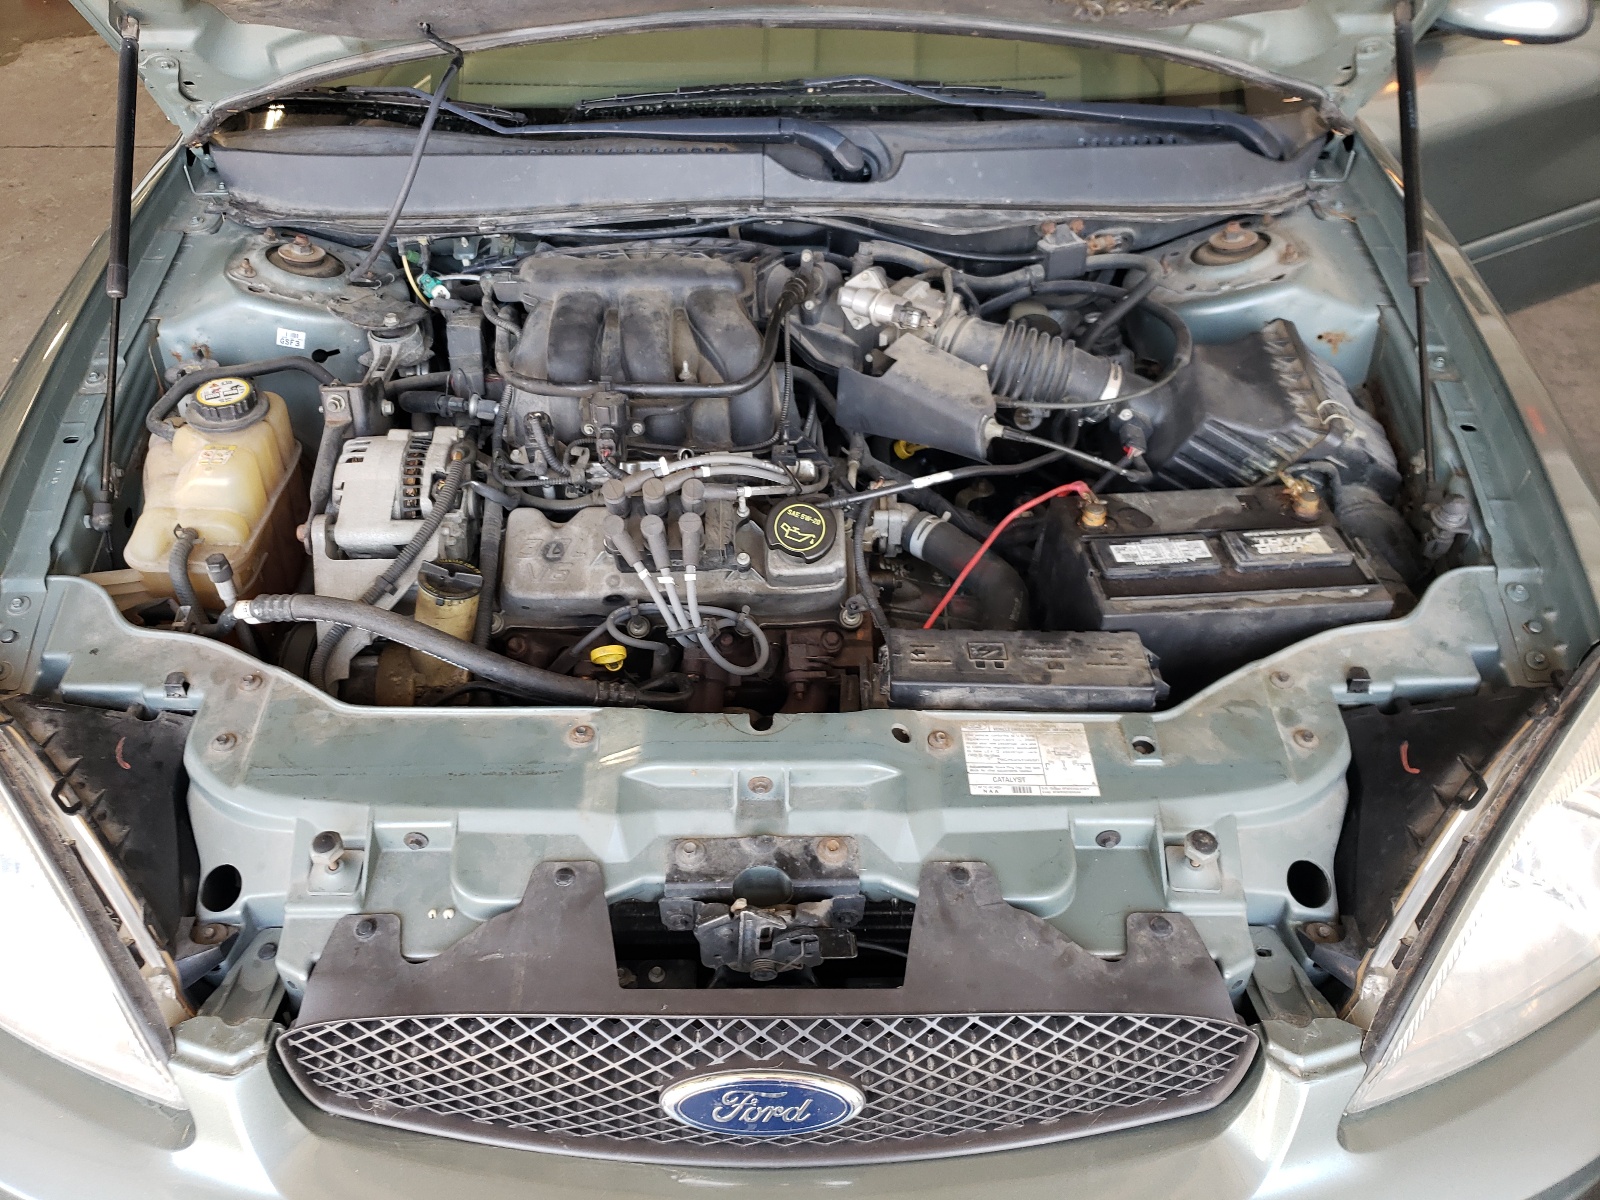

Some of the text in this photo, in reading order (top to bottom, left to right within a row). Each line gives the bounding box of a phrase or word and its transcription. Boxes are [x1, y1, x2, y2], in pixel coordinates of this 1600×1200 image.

[786, 508, 822, 526] SAE 5W-20
[516, 537, 587, 559] 30L
[711, 1090, 814, 1123] Ford
